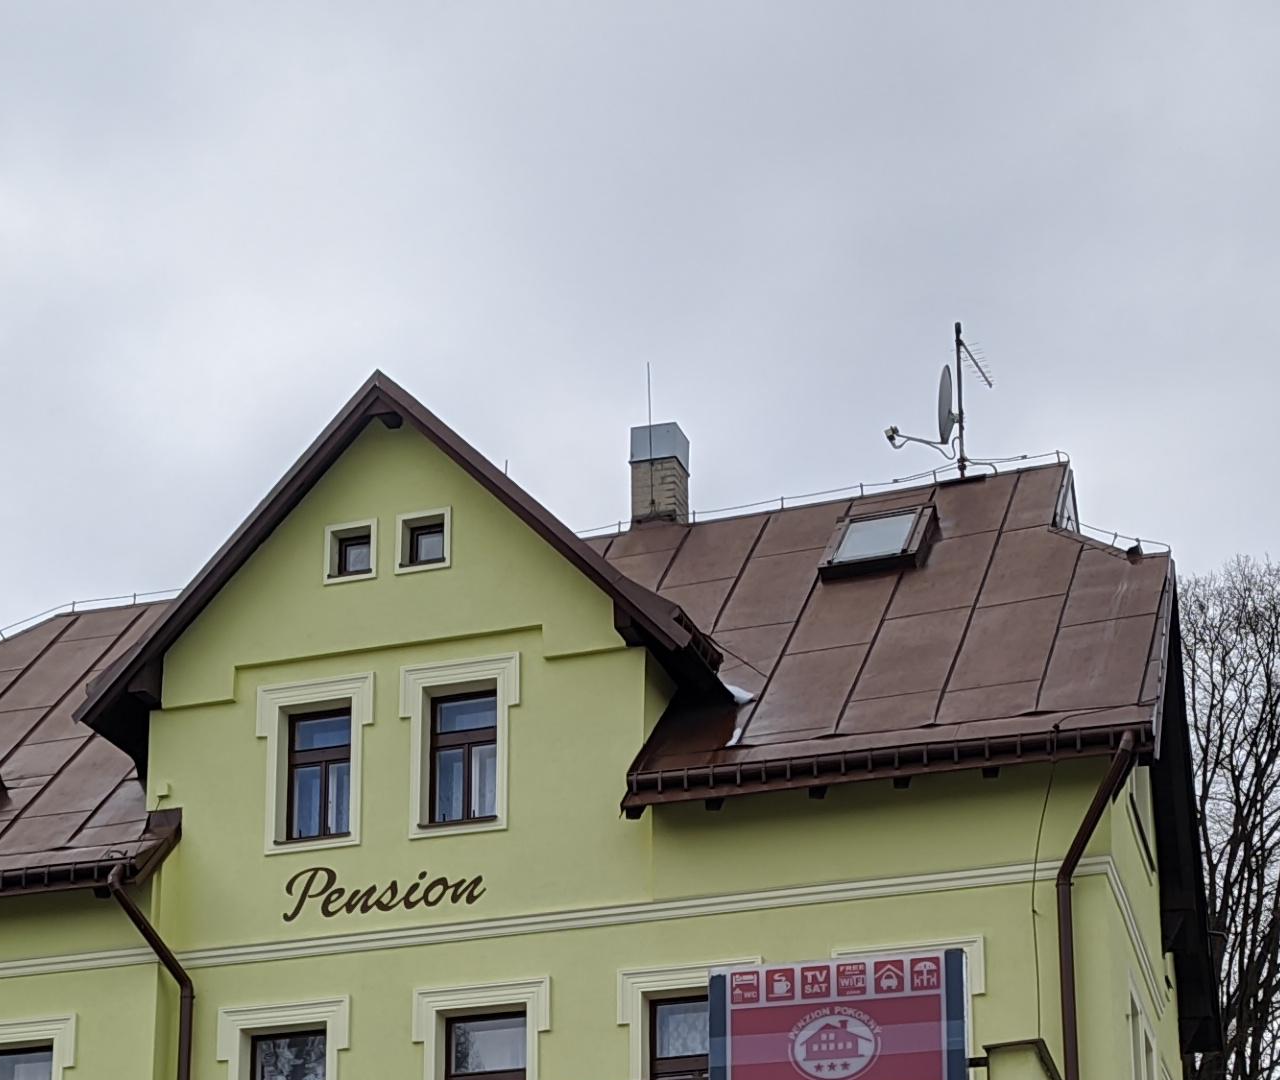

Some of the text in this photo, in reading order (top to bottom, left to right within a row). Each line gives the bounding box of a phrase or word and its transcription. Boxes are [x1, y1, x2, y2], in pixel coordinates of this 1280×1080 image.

[282, 867, 487, 922] Pension
[803, 969, 827, 984] TV
[743, 991, 758, 999] WC
[804, 983, 827, 994] SAT
